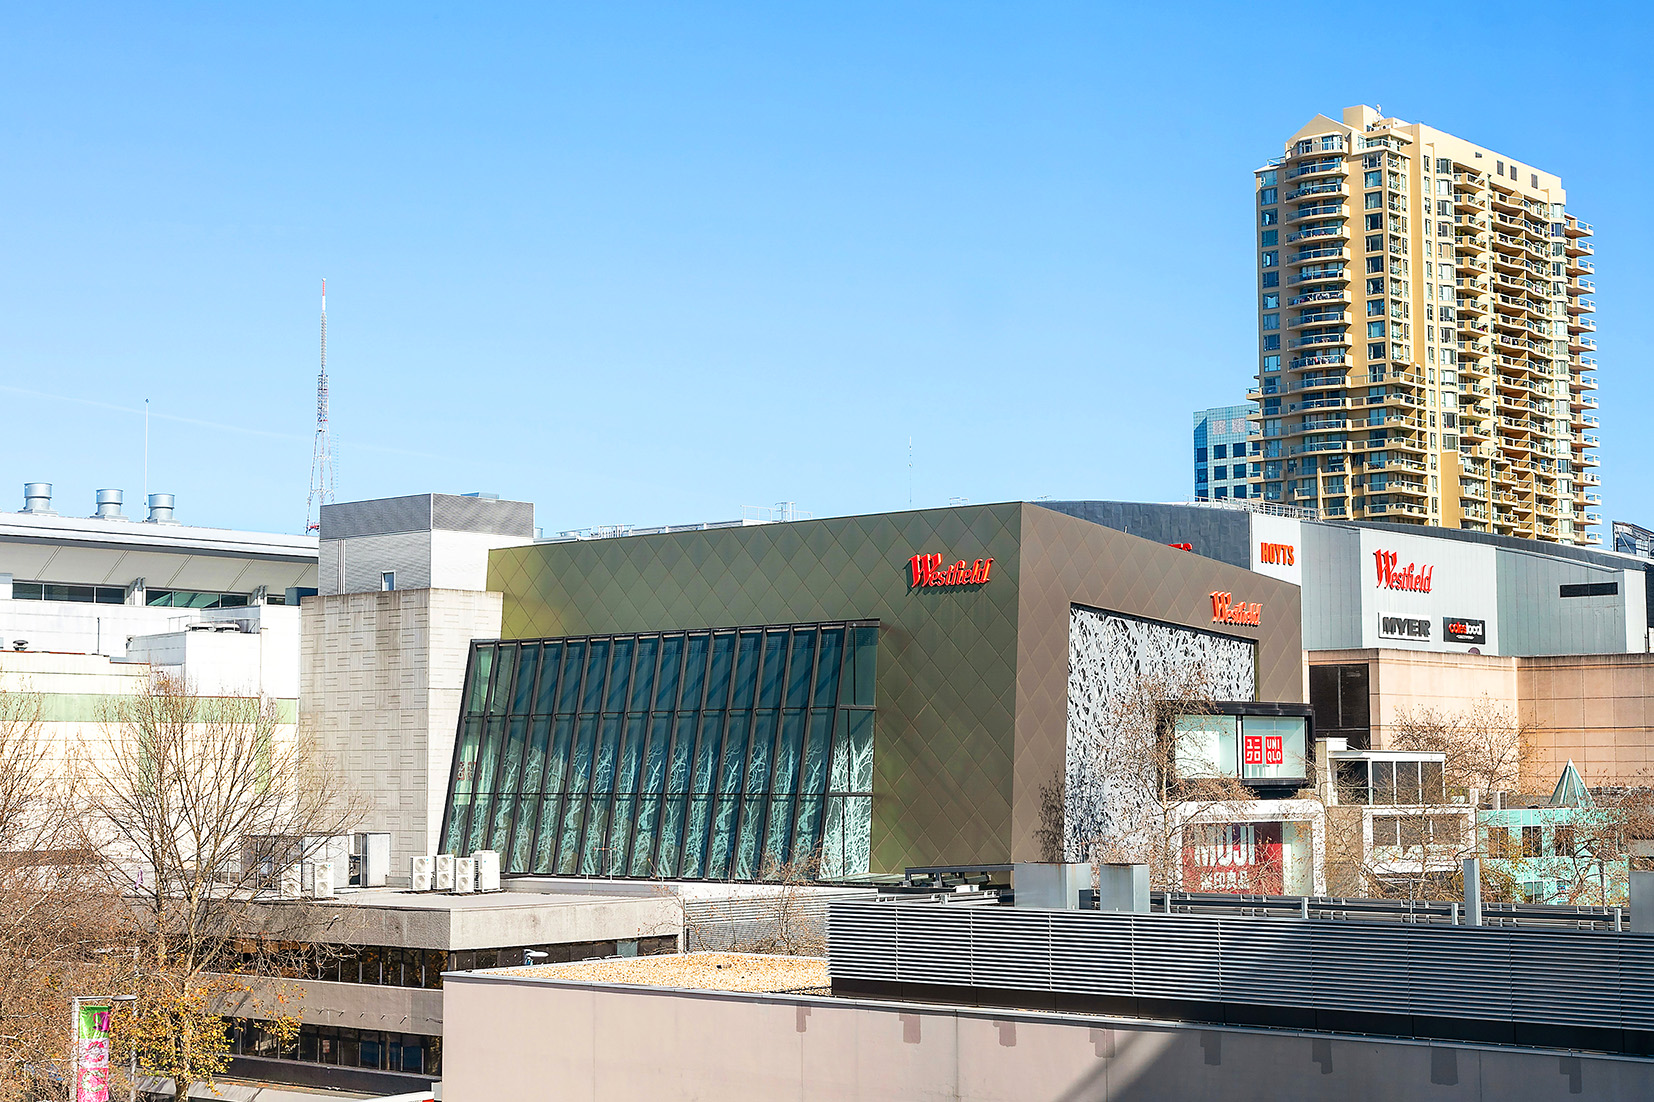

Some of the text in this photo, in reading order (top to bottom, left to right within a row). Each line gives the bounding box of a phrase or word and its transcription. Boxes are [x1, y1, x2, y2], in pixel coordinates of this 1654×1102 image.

[1260, 542, 1295, 566] HOYTS
[908, 552, 995, 588] Westfield
[1372, 548, 1434, 594] Westfield
[1208, 590, 1263, 627] Westfield
[1382, 616, 1431, 637] MYER
[1266, 738, 1280, 750] UNI
[1267, 750, 1281, 762] QLO
[1194, 825, 1255, 867] MUJI
